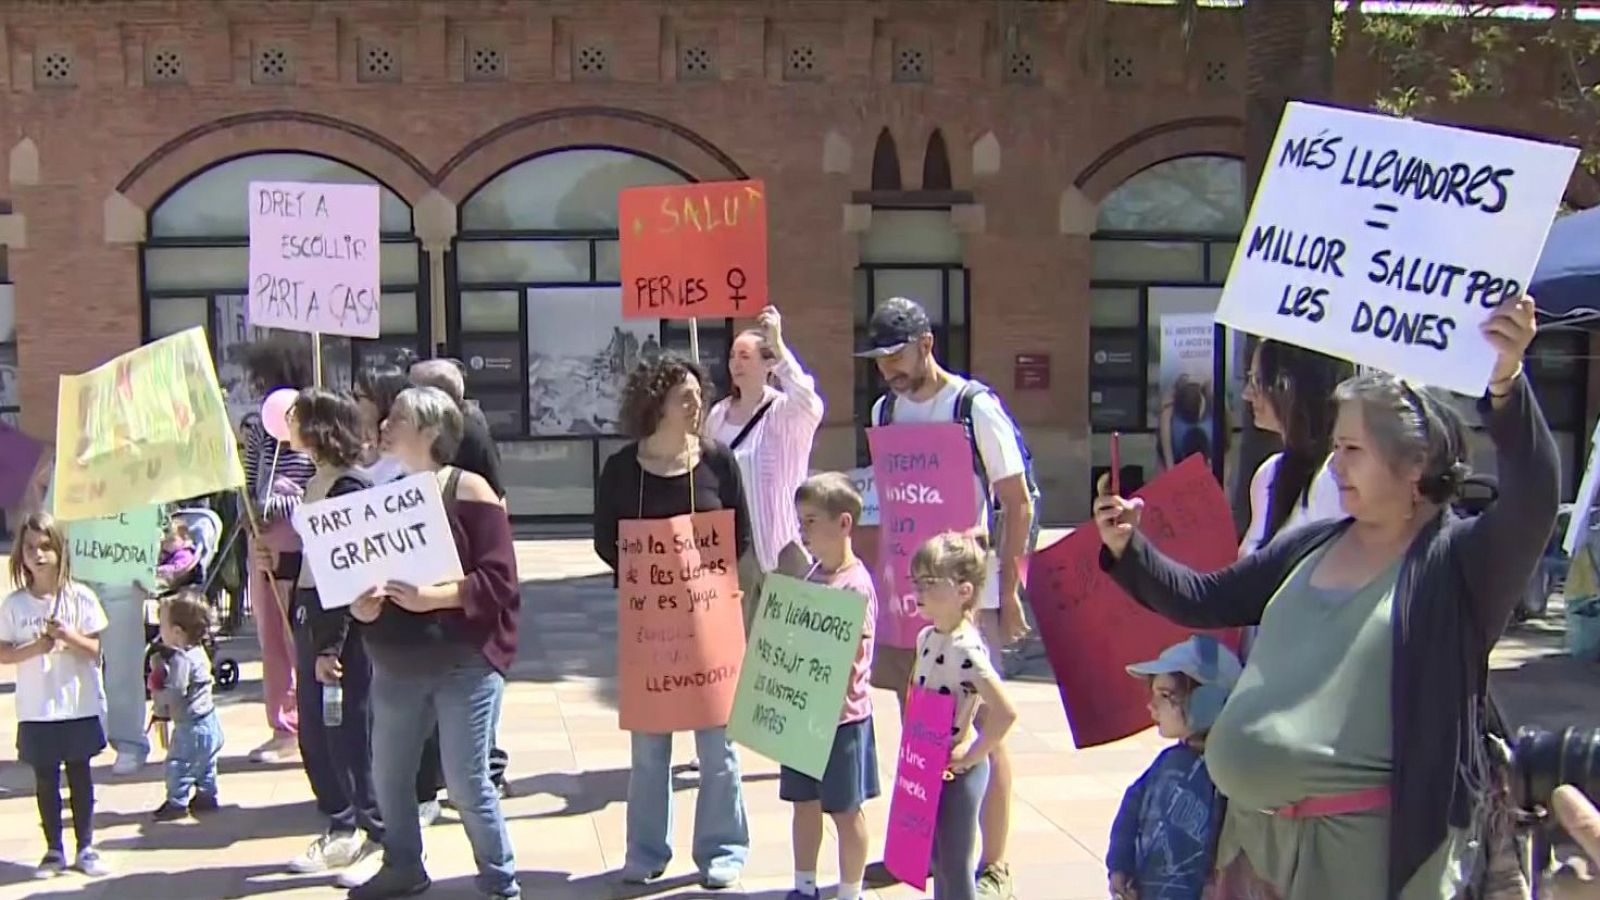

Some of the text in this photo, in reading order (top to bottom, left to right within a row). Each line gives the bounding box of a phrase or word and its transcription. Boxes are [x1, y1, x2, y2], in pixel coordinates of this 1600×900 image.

[1279, 130, 1342, 169] MÉS
[259, 190, 329, 217] DRET A
[658, 187, 762, 233] SALUT
[1246, 225, 1347, 277] MILLOR
[1368, 250, 1466, 297] SALUT
[256, 273, 305, 320] PART
[306, 290, 319, 322] A
[1351, 300, 1456, 350] DONES
[308, 487, 425, 536] PART A CASA
[330, 522, 428, 570] GRATUIT
[648, 534, 666, 553] la
[650, 564, 674, 584] les
[658, 595, 677, 609] es
[687, 587, 718, 612] juga
[809, 658, 831, 684] PER
